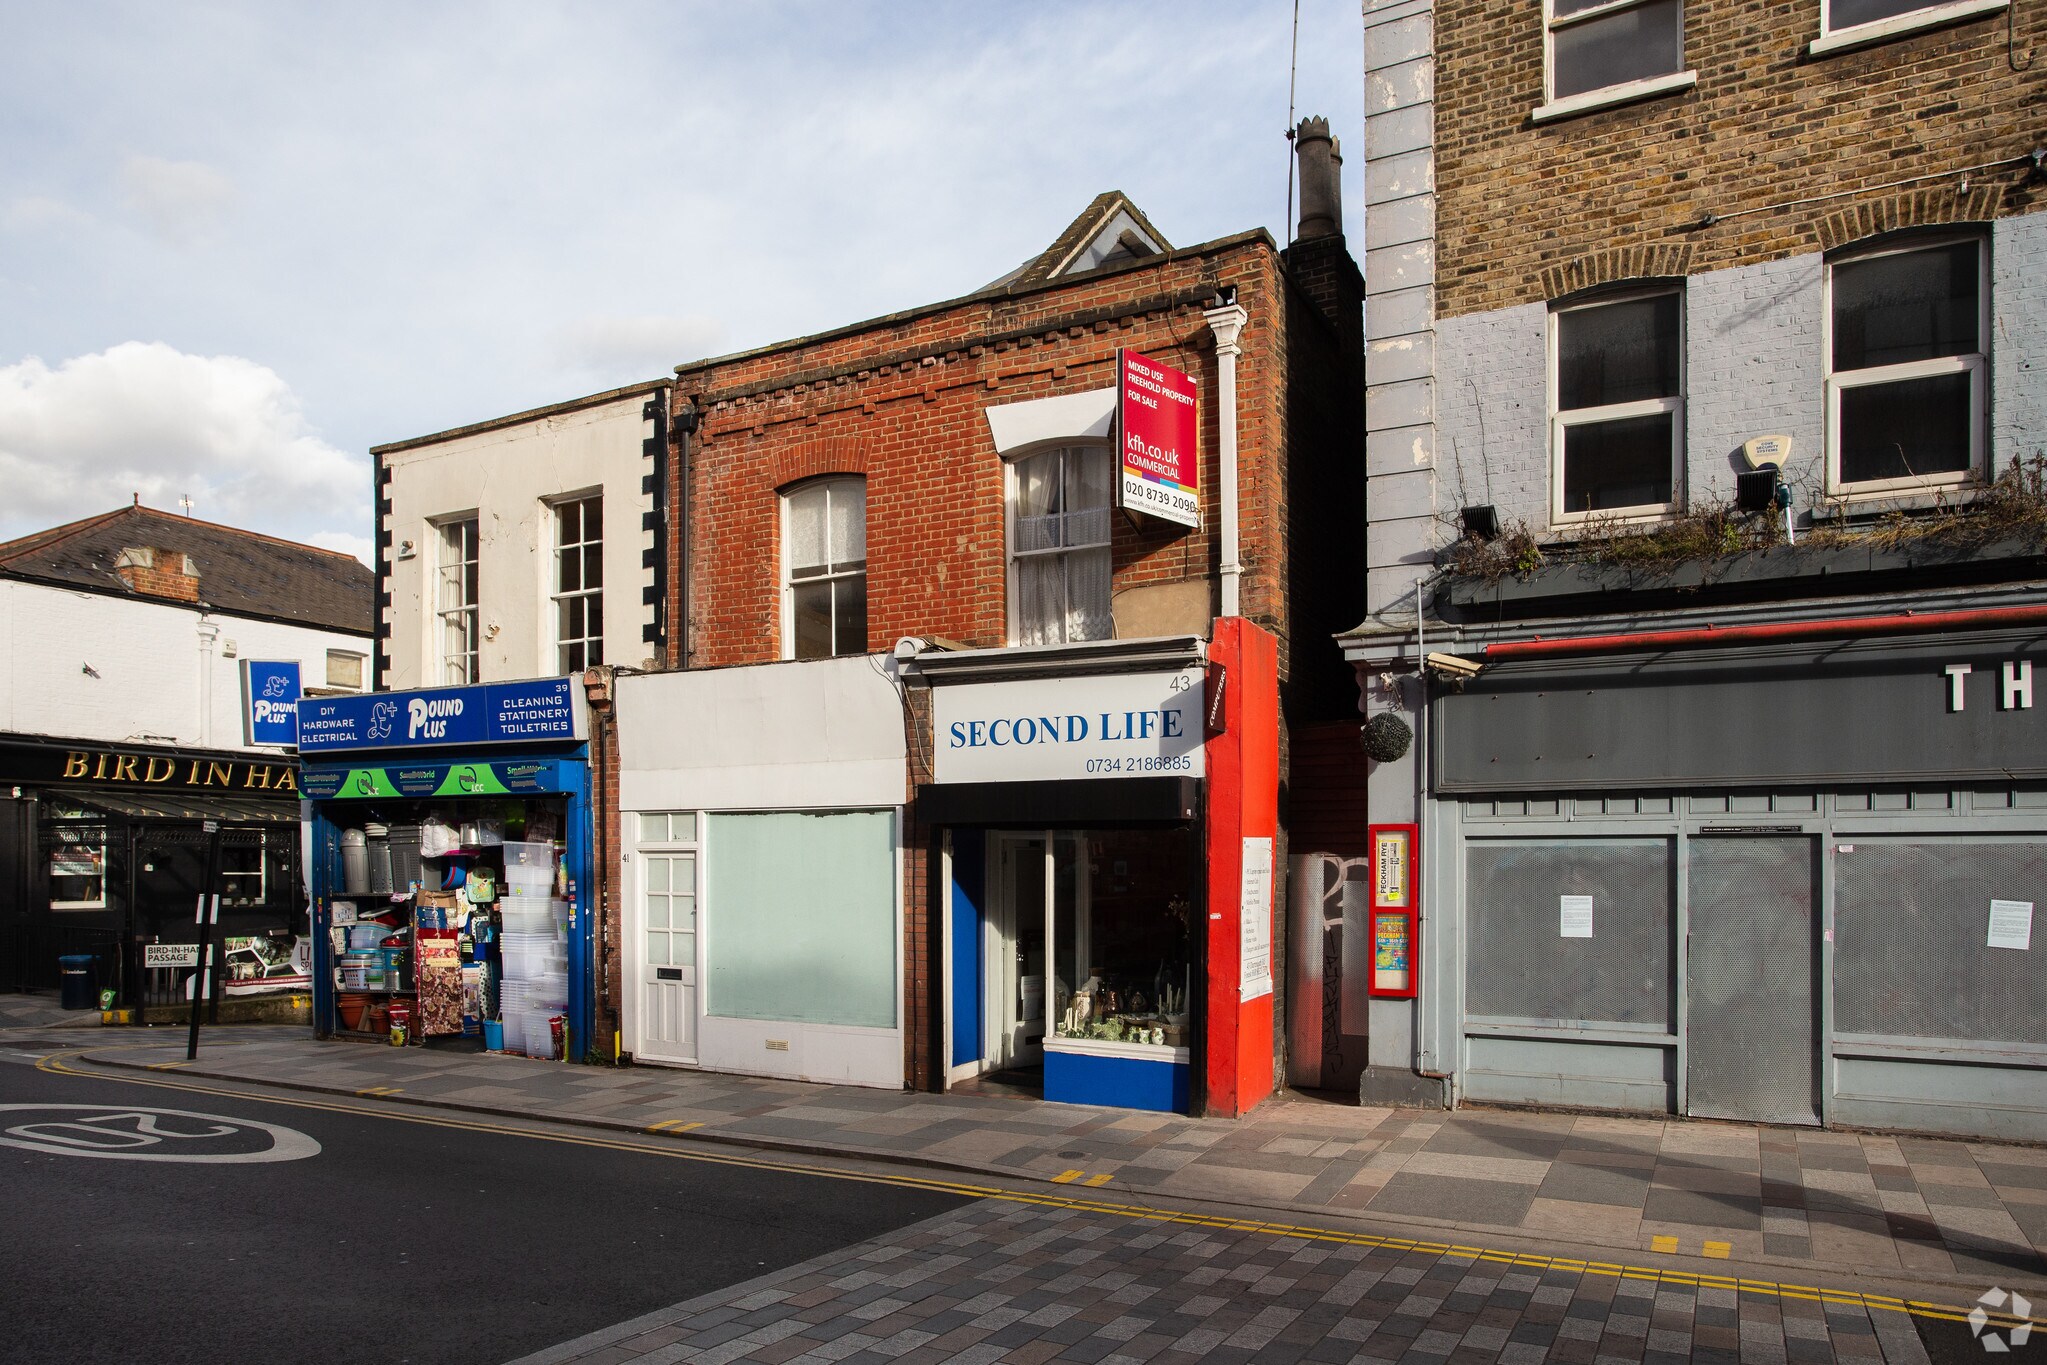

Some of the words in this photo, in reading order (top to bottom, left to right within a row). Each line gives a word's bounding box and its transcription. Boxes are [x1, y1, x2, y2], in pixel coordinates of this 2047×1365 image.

[1128, 360, 1150, 376] MIXED
[1152, 369, 1164, 382] USE
[1128, 372, 1160, 393] FREEHOLD
[1162, 386, 1194, 406] PROPERTY
[1128, 390, 1140, 402] FOR
[1142, 396, 1158, 410] SALE
[1128, 432, 1179, 466] kfh.co.uk
[1128, 453, 1180, 480] COMMERCIAL
[1126, 481, 1144, 497] 020
[1146, 488, 1169, 505] 8739
[1173, 496, 1196, 513] 2090
[1169, 675, 1191, 692] 43
[503, 696, 562, 708] CLEANING
[1210, 668, 1226, 727] COMPUTERS
[321, 707, 335, 715] DIY
[499, 708, 569, 722] STATIONERY
[303, 719, 354, 729] HARDWARE
[501, 721, 568, 733] TOILETRIES
[950, 714, 1089, 749] SECOND
[1098, 709, 1183, 741] LIFE
[302, 733, 358, 743] ELECTRICAL
[63, 751, 176, 782] BIRD
[186, 760, 233, 786] IN
[1086, 758, 1121, 773] 0734
[1126, 756, 1191, 772] 2186885
[471, 784, 485, 792] LCC
[622, 854, 629, 862] 41
